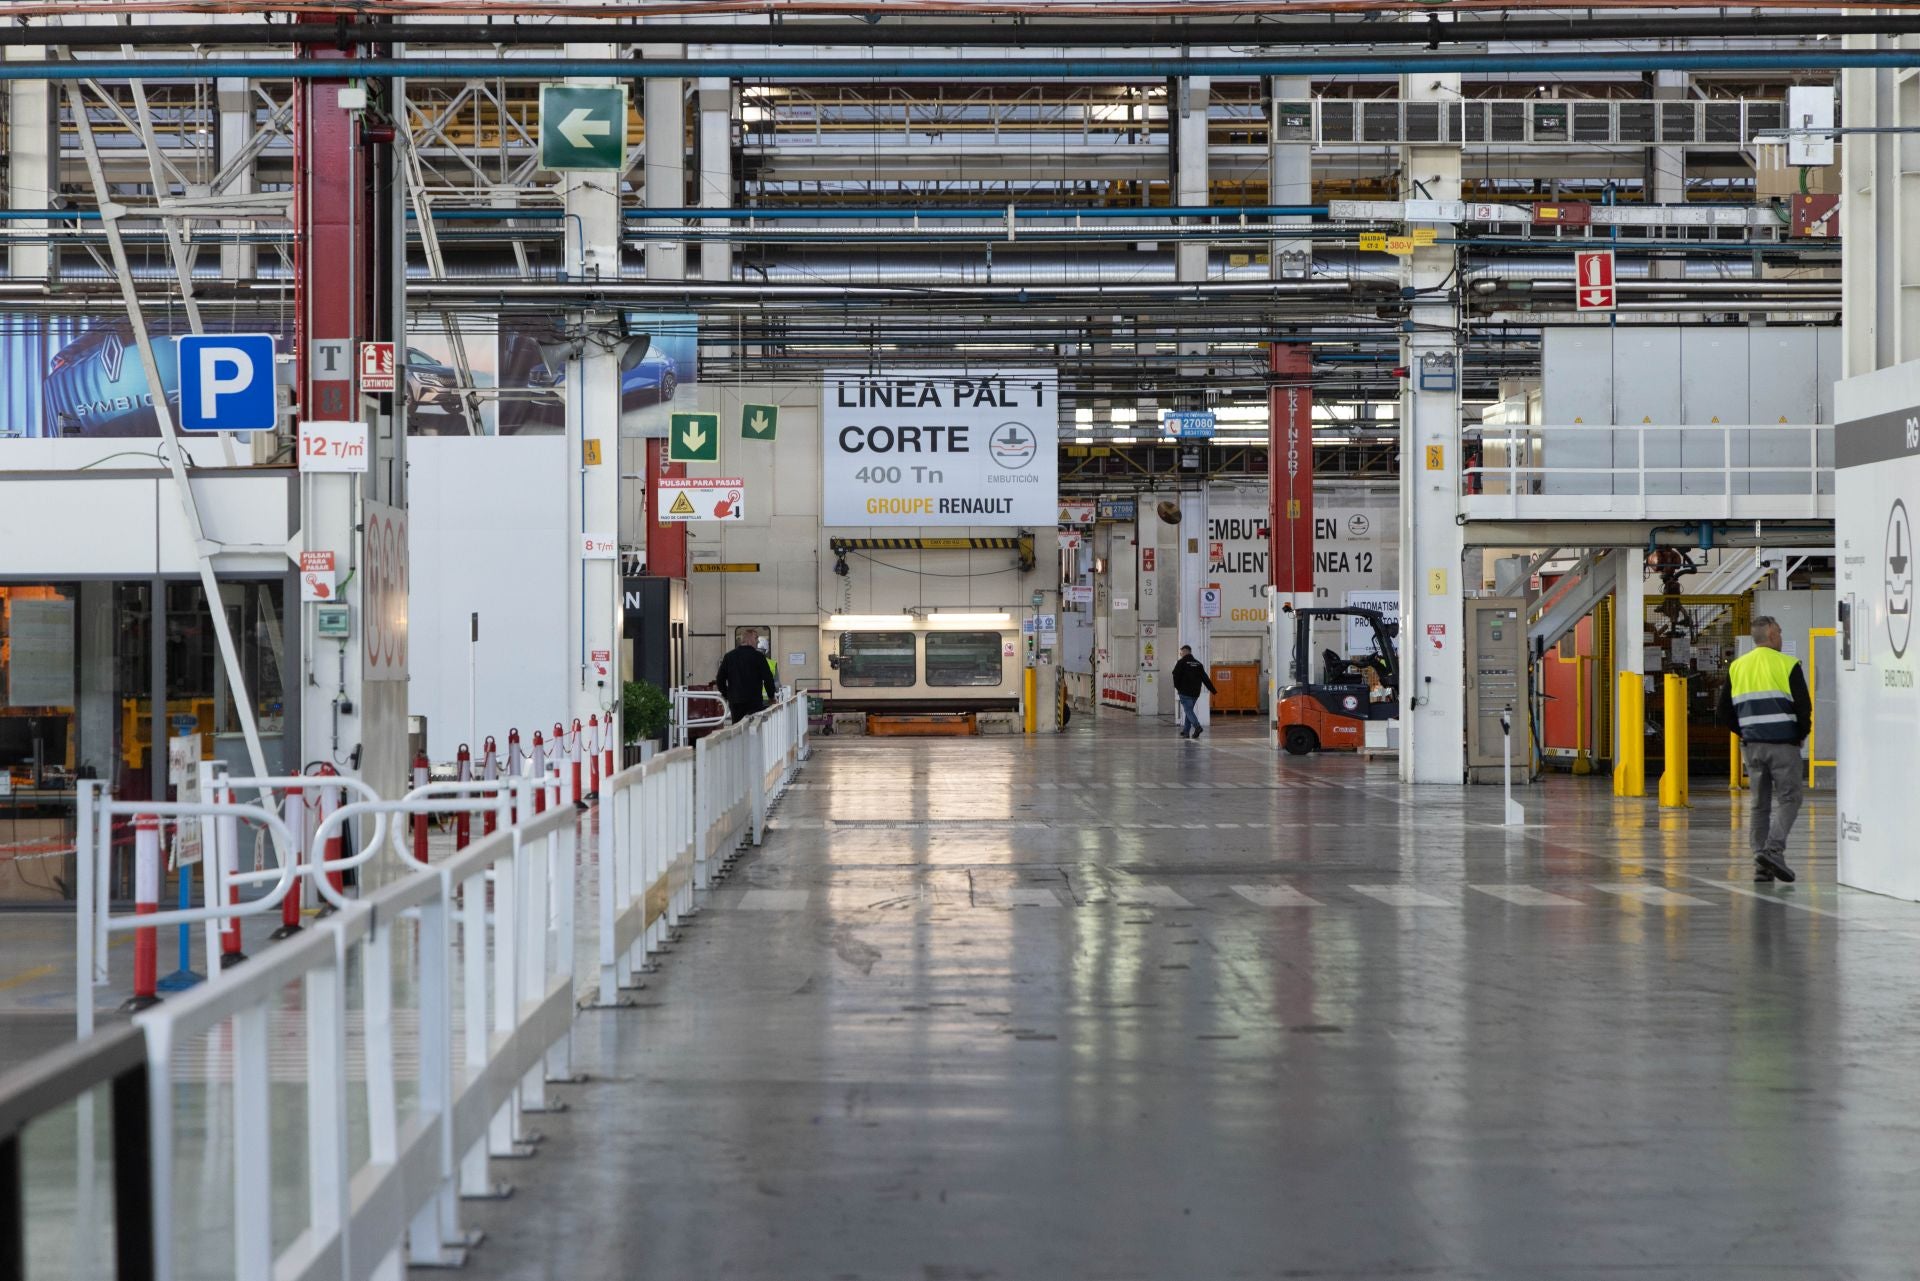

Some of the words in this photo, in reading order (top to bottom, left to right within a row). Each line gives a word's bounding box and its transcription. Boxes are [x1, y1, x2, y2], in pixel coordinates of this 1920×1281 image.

[319, 345, 342, 371] T
[199, 347, 254, 419] P
[362, 379, 394, 387] EXTINTOR
[1031, 381, 1043, 408] 1
[1183, 419, 1213, 428] 27080
[303, 437, 327, 456] 12
[838, 425, 970, 454] CORTE
[660, 479, 691, 487] PULSAR
[715, 478, 742, 486] PASAR
[855, 466, 902, 484] 400
[910, 466, 944, 484] Tn
[987, 474, 1039, 484] EMBUTICIÓN
[866, 497, 934, 514] GROUPE
[939, 498, 1014, 514] RENAULT
[1315, 518, 1337, 540] EN
[585, 540, 593, 551] 8
[1354, 551, 1373, 573] 12
[622, 591, 640, 610] N
[1231, 607, 1269, 622] GROU
